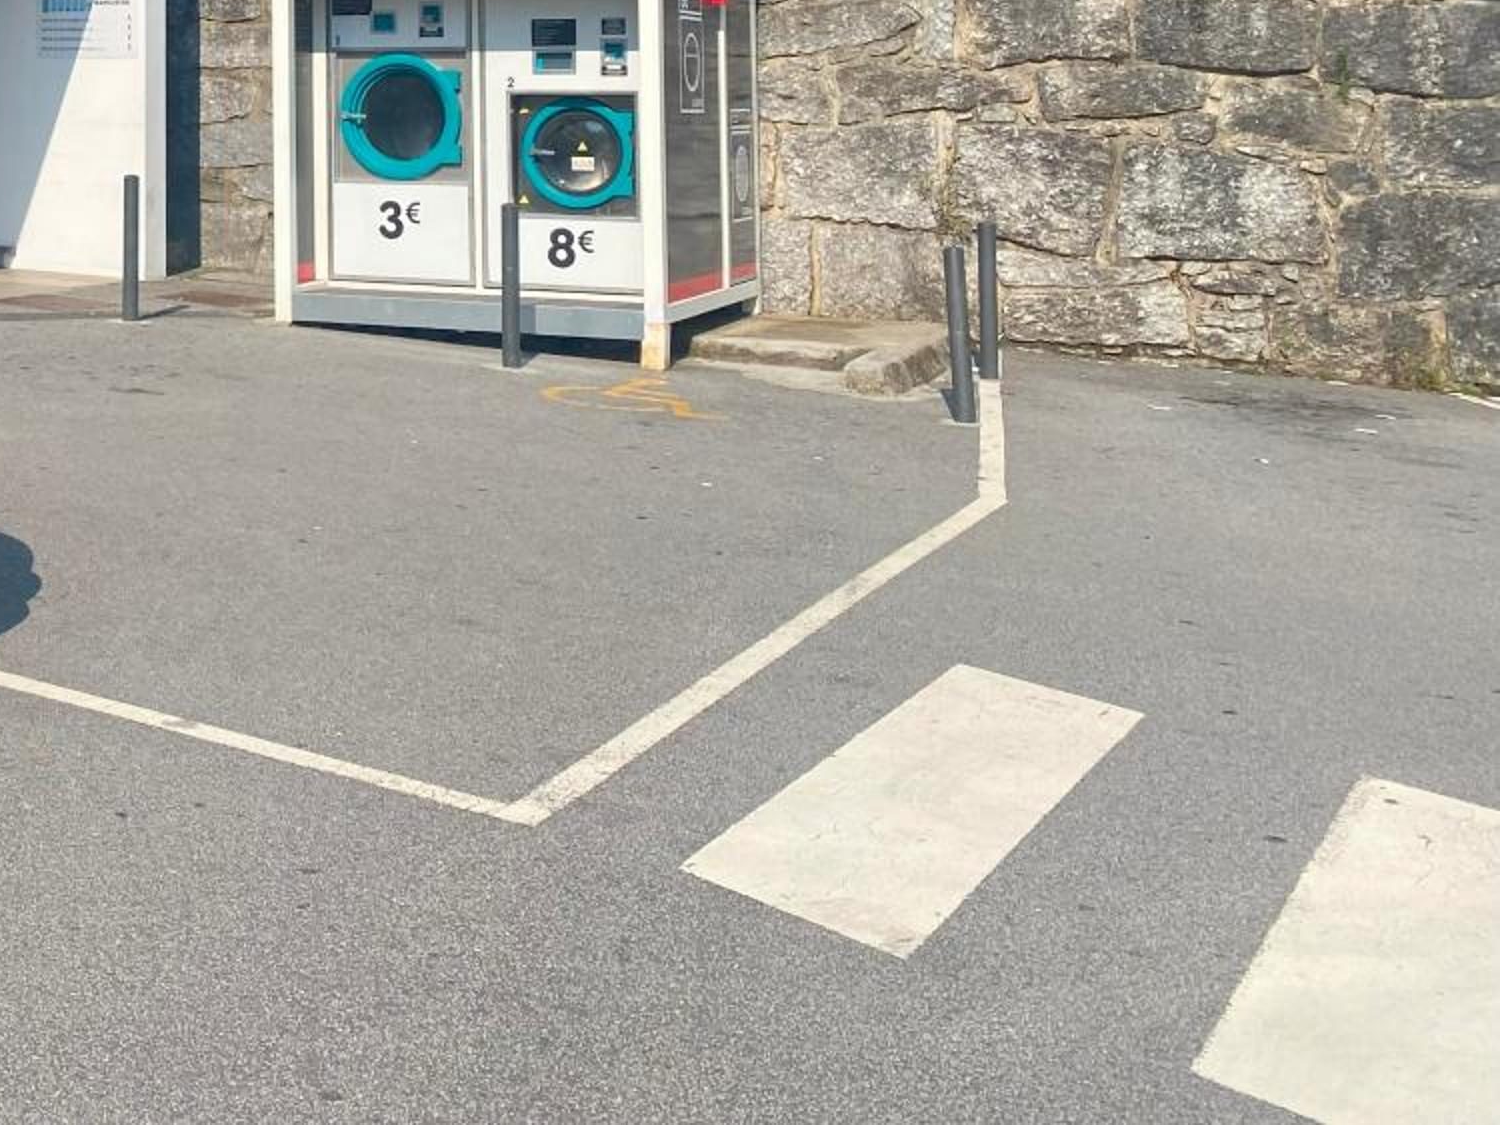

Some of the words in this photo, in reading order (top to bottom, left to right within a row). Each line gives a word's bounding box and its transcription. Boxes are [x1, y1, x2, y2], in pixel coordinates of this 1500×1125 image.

[507, 76, 516, 89] 2
[379, 200, 420, 239] 3€
[547, 228, 595, 268] 8€
